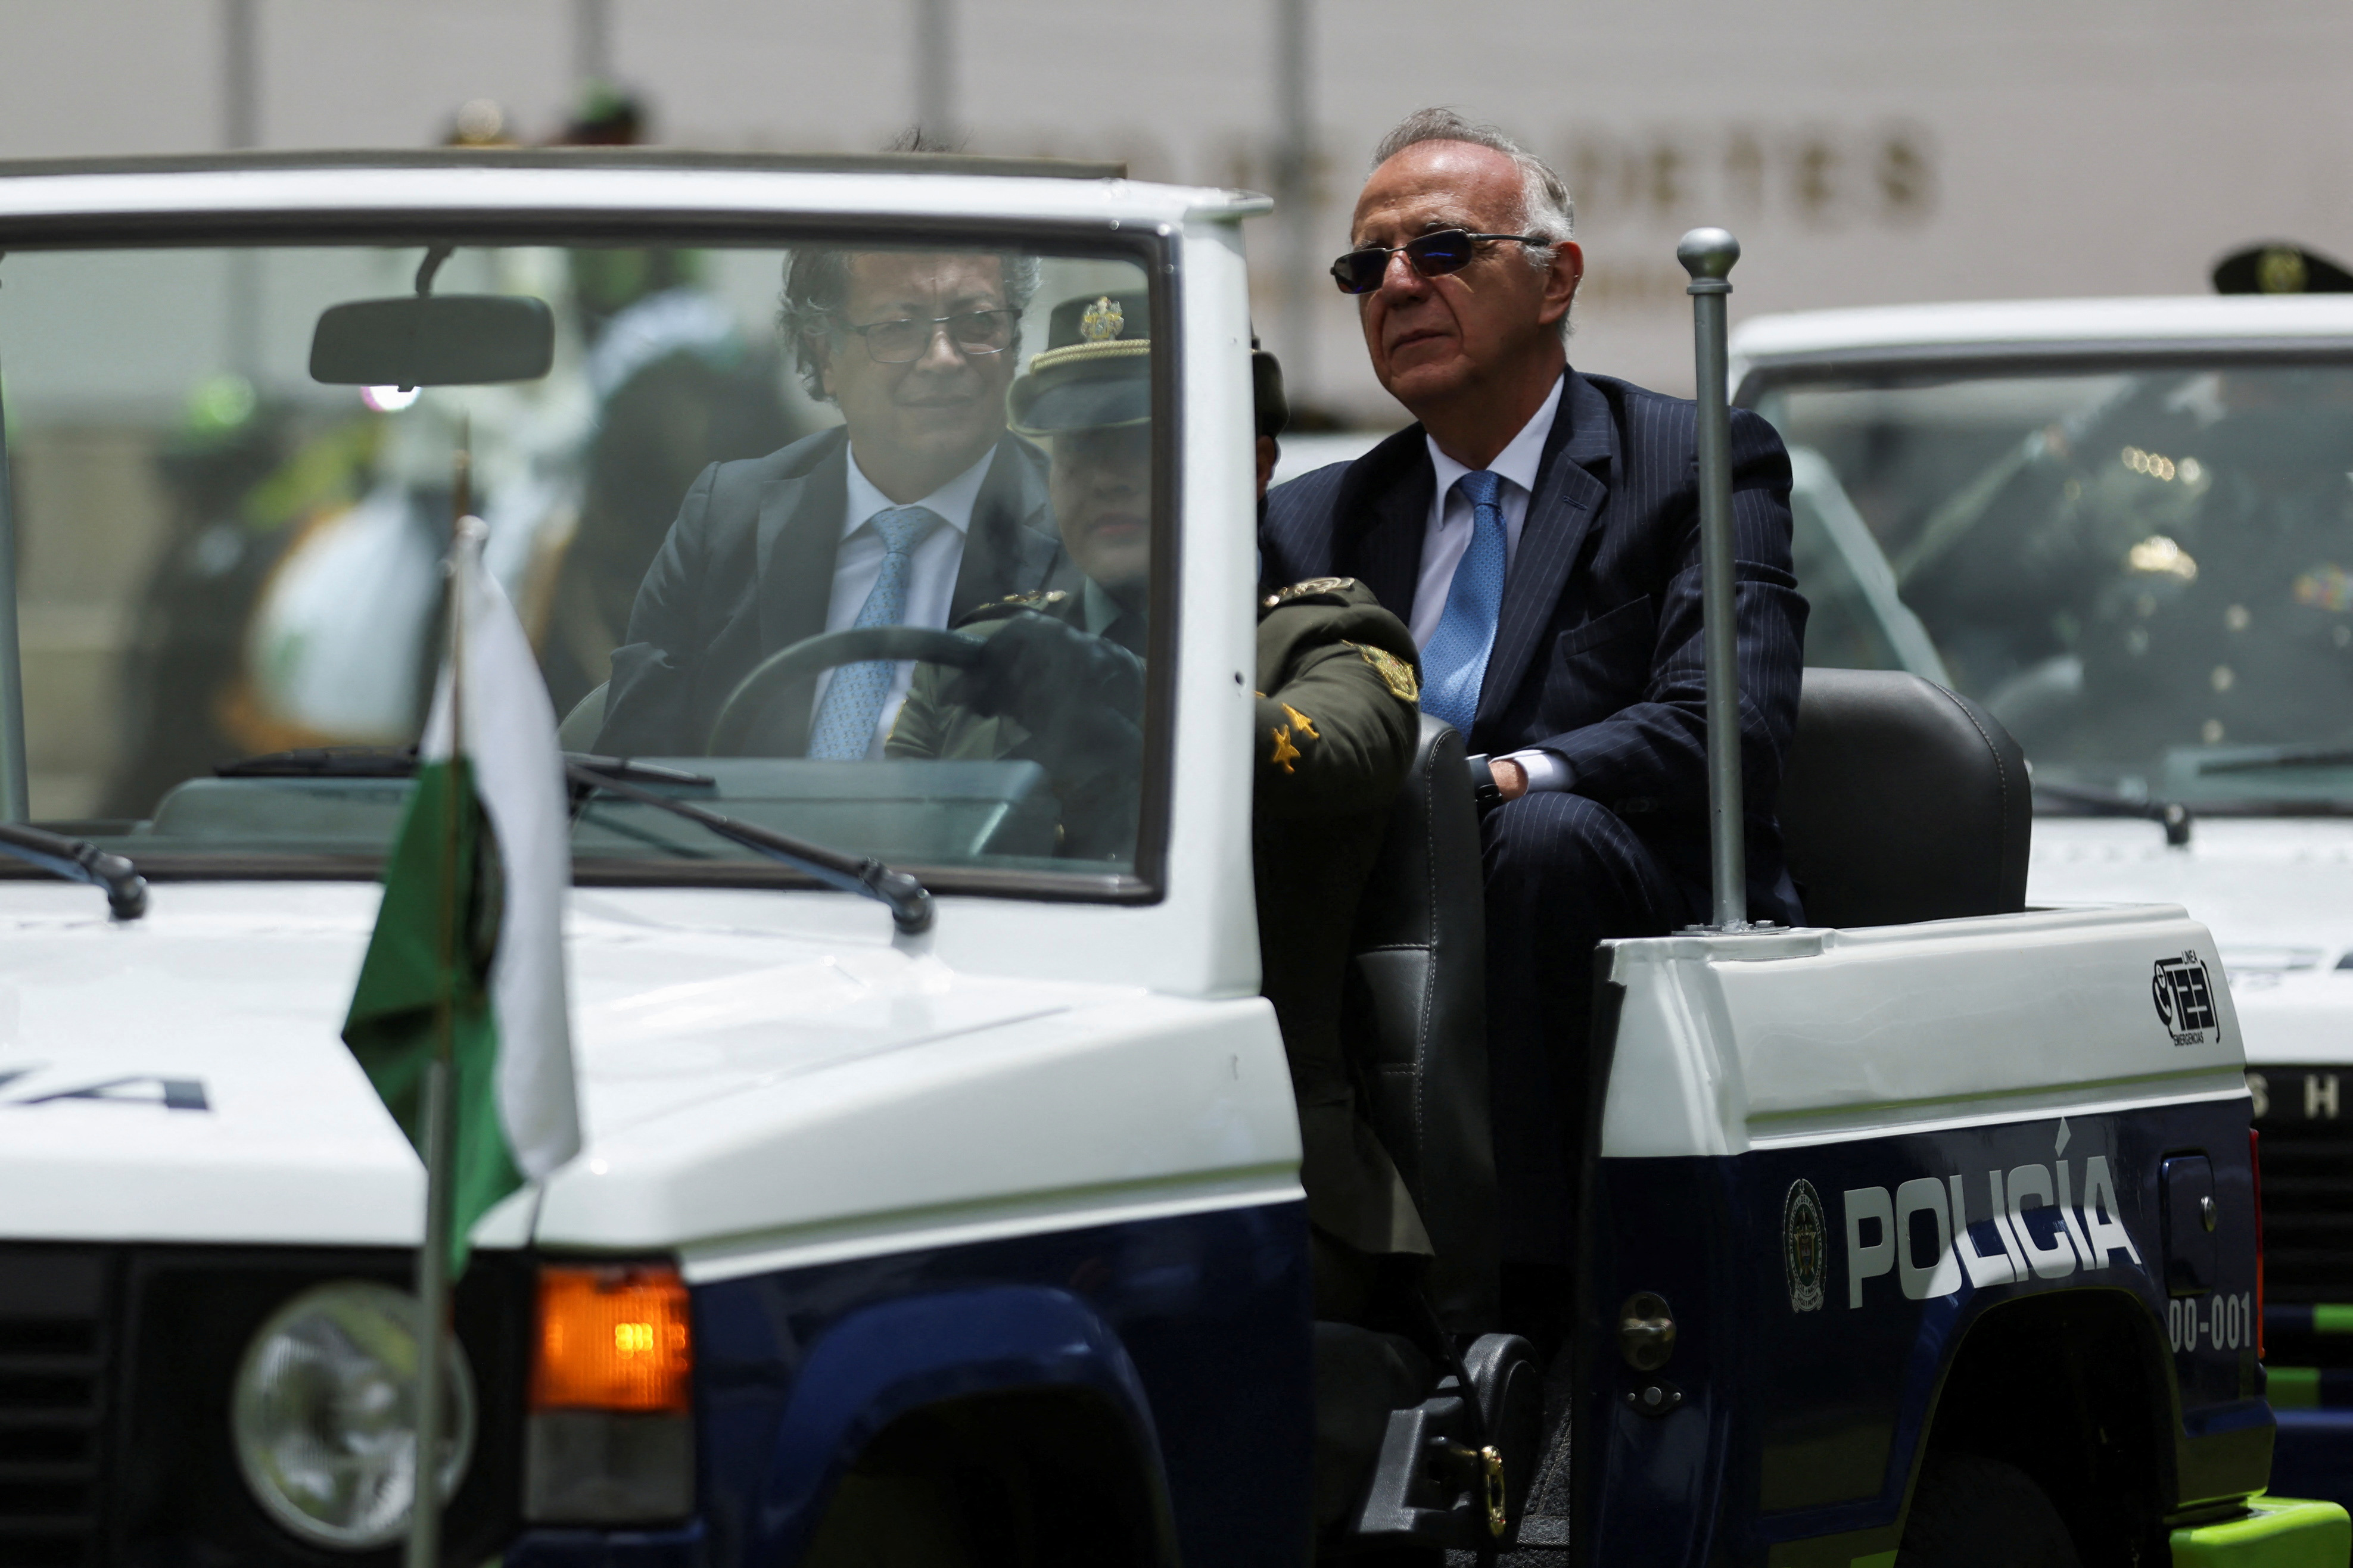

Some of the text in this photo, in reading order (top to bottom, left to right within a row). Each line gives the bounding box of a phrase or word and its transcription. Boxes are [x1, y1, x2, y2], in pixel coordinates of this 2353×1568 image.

[2165, 967, 2215, 1031] 123
[1844, 1116, 2143, 1309] POLICÍA
[2169, 1290, 2251, 1353] 00-001
